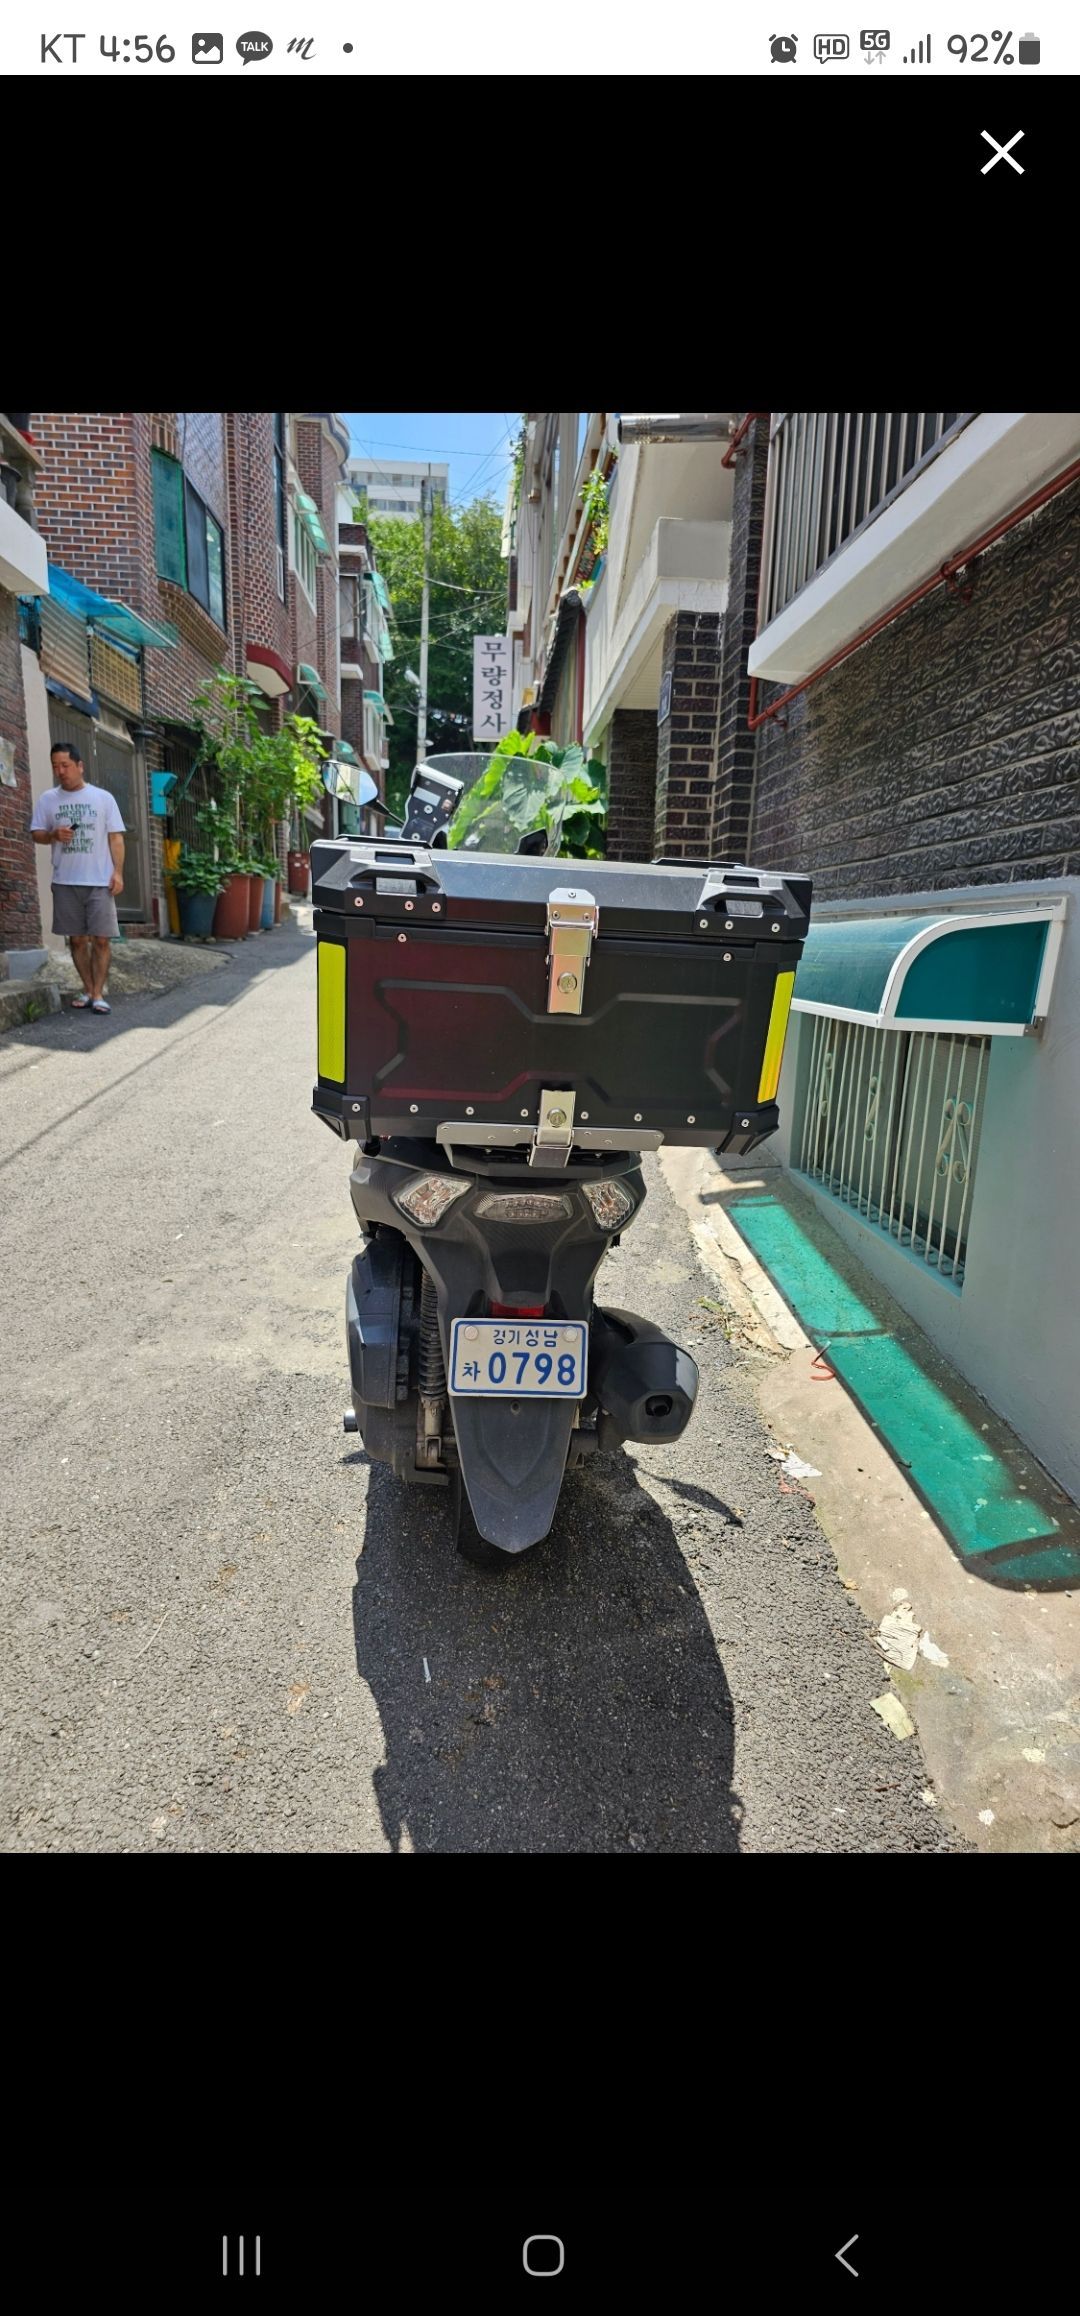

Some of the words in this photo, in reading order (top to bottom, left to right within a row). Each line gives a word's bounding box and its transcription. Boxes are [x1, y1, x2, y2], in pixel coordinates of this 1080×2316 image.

[480, 641, 508, 733] 무량정사
[493, 1329, 520, 1345] 경기
[525, 1329, 558, 1347] 성남
[462, 1361, 481, 1382] 차
[488, 1351, 576, 1386] 0798
